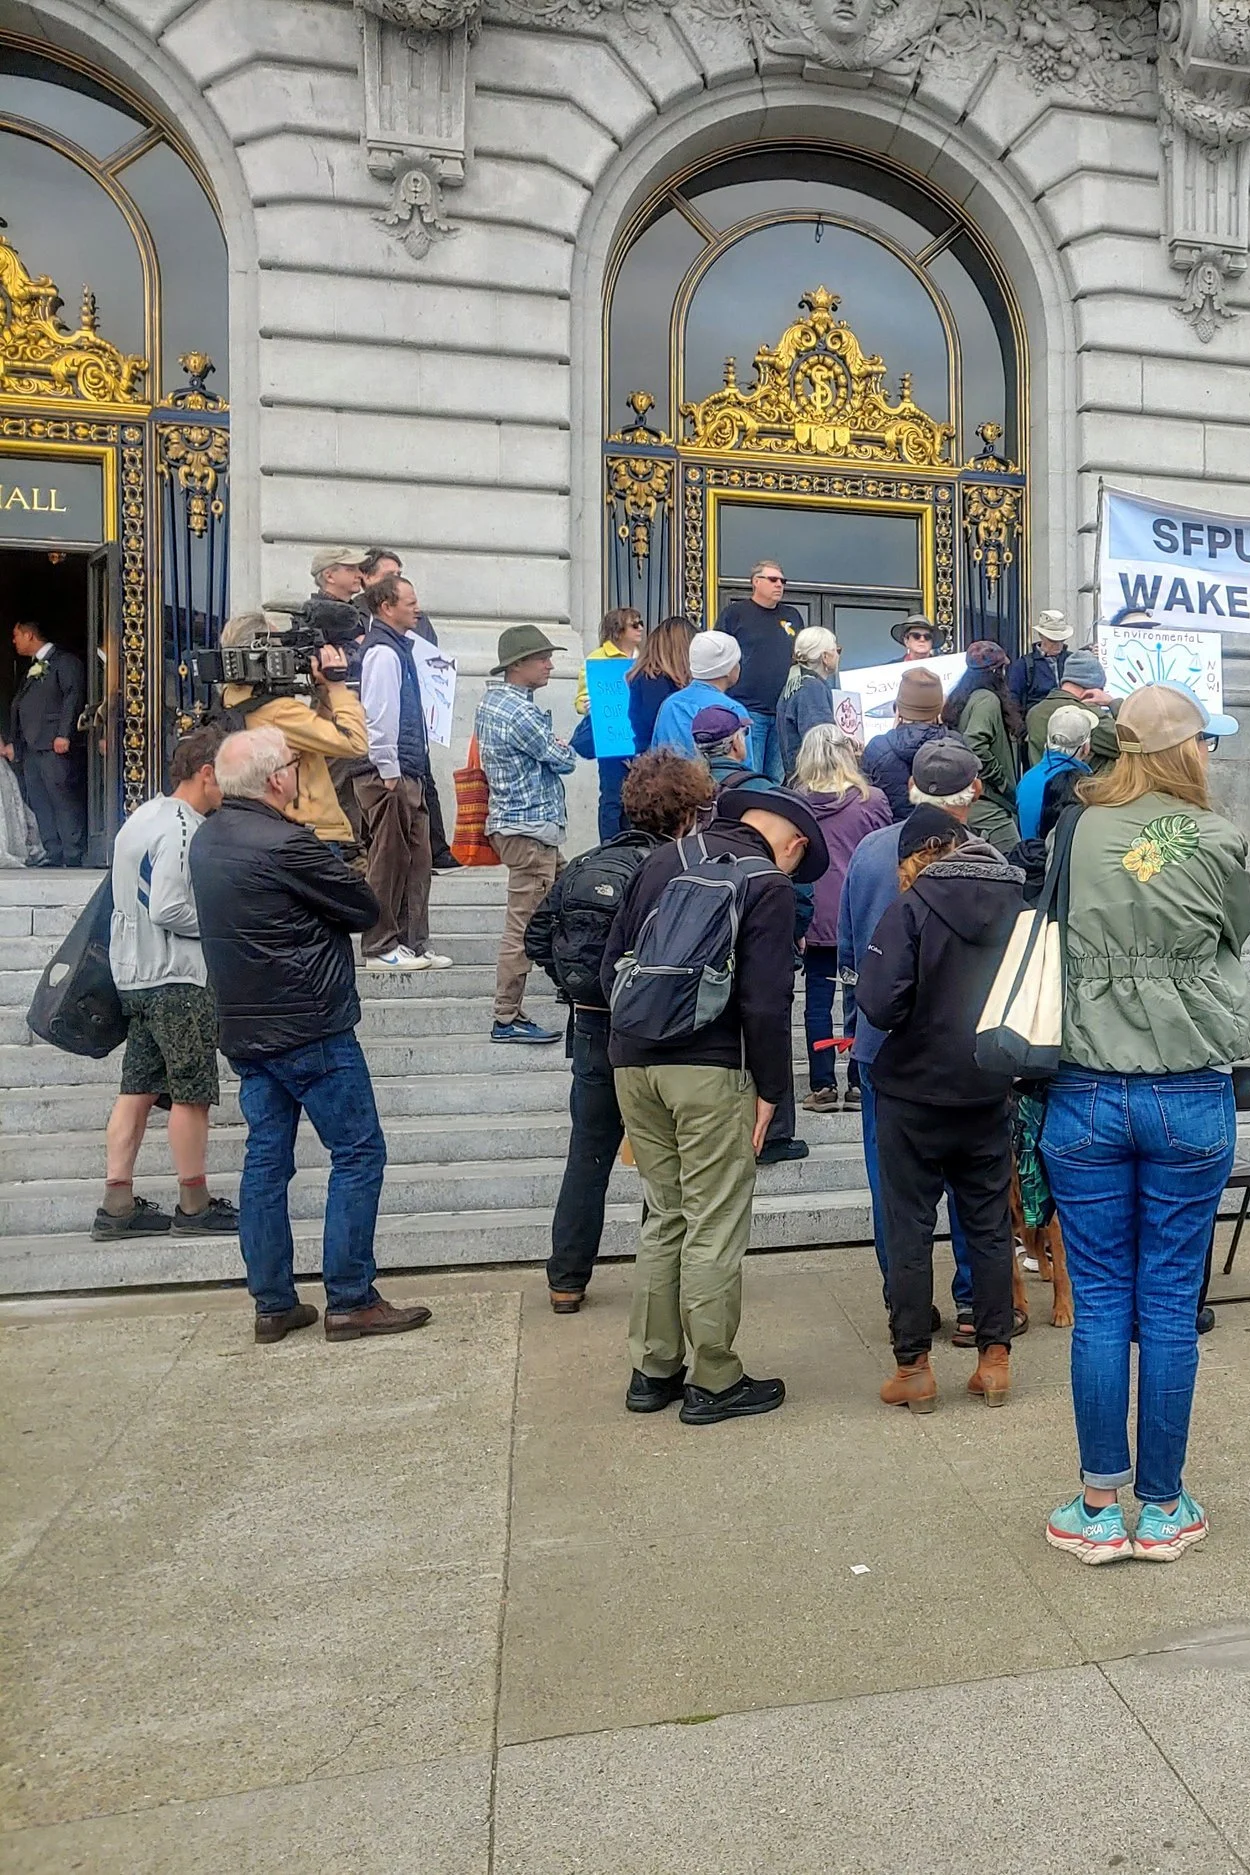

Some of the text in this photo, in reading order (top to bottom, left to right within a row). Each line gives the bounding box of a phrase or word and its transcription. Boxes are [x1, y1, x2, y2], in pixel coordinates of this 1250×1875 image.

[0, 484, 67, 512] ALL
[1118, 573, 1250, 618] WAKE
[864, 680, 899, 695] Sav
